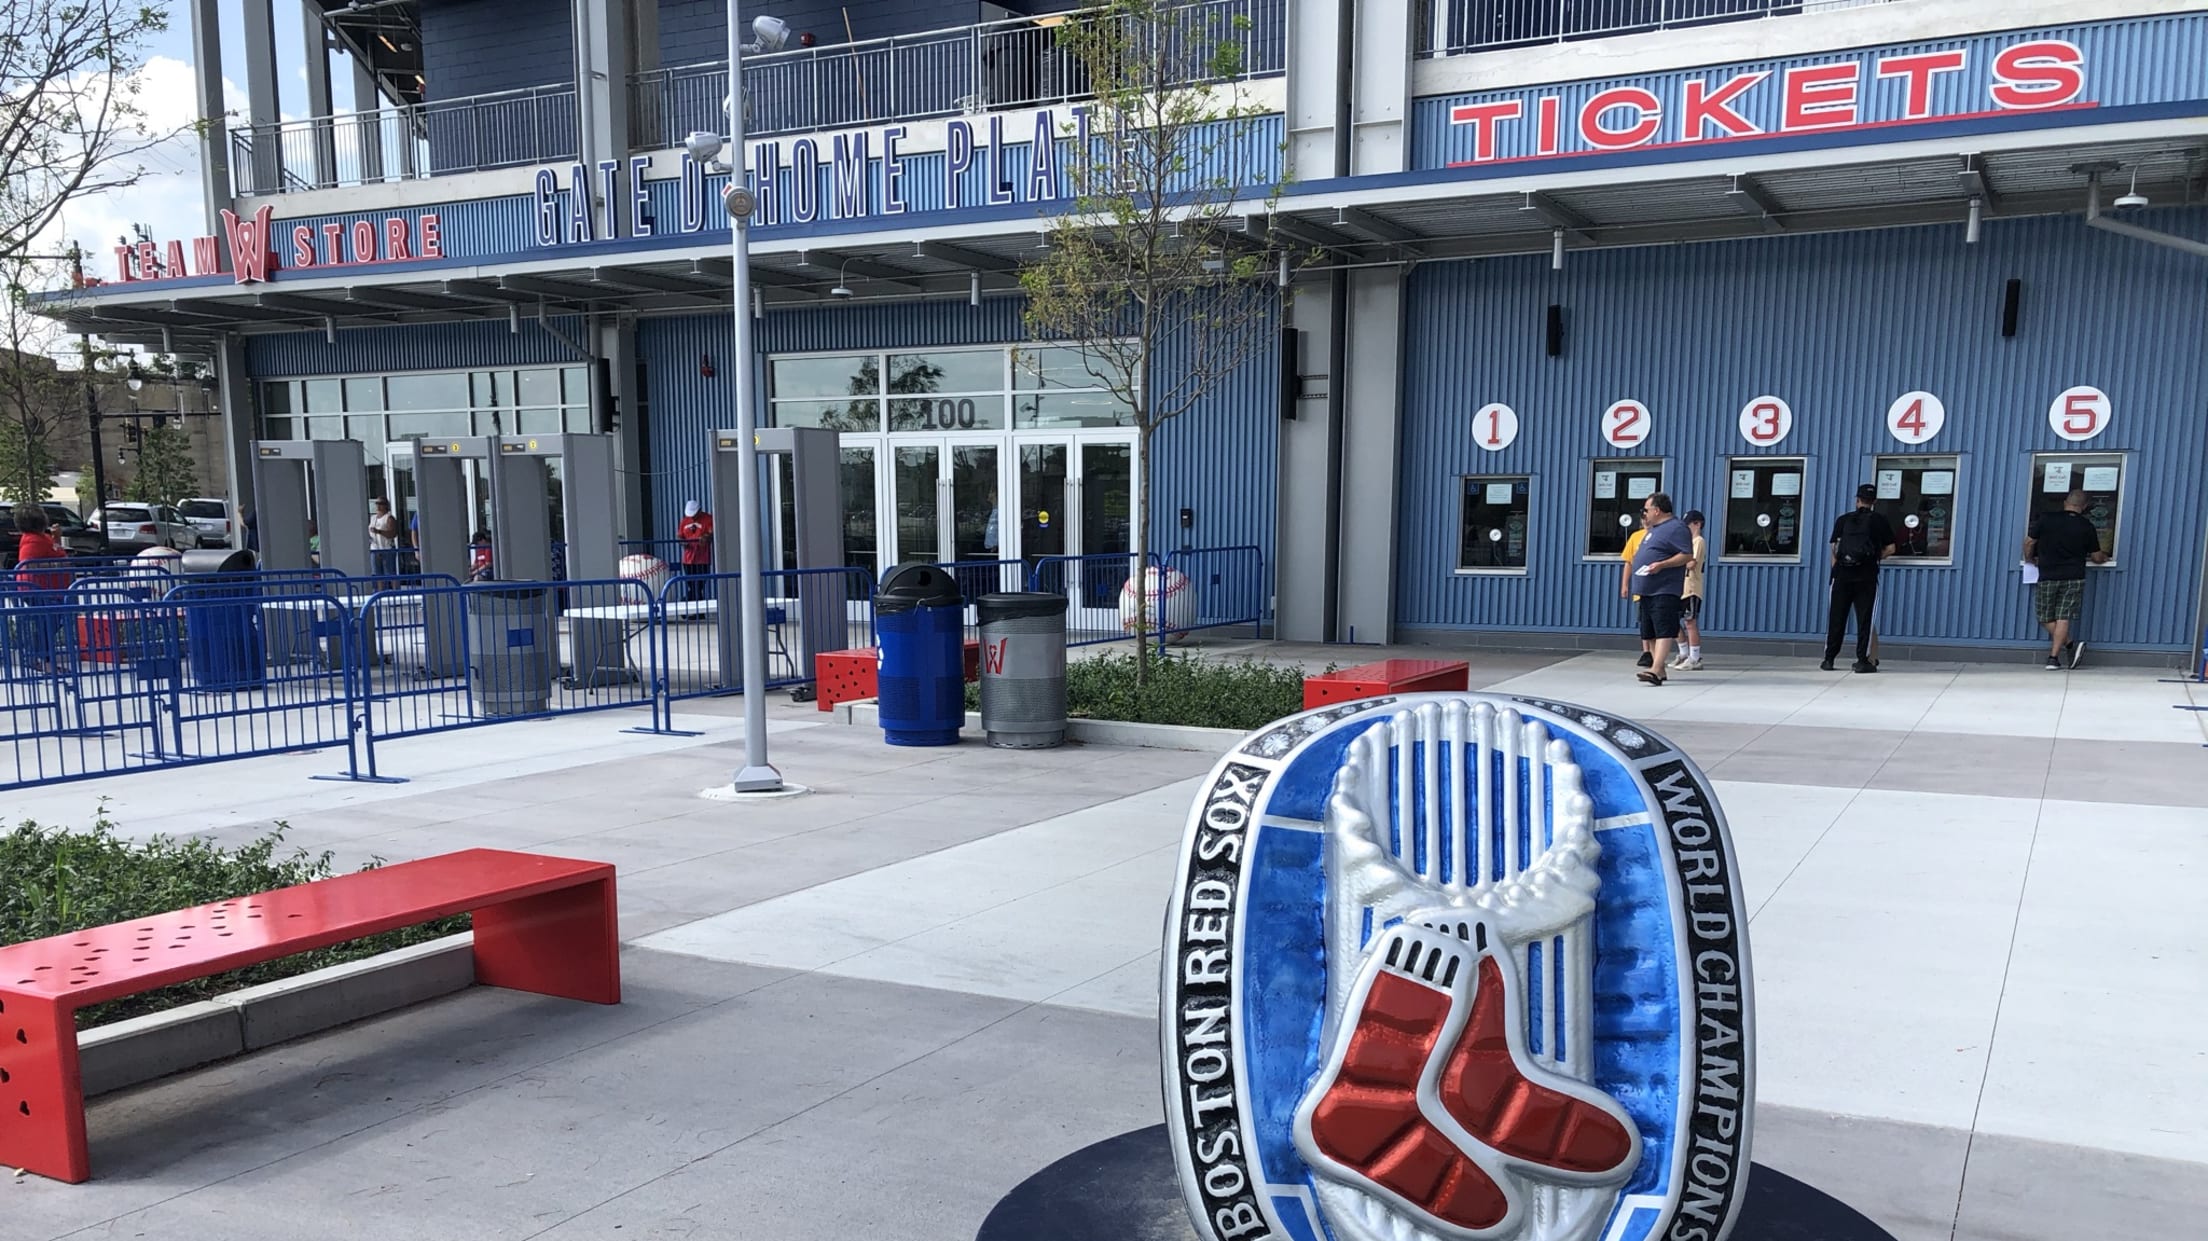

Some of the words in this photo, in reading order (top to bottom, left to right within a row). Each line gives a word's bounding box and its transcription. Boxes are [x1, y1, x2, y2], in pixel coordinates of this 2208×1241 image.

[1450, 39, 2085, 162] TICKETS
[535, 155, 652, 247] GATE
[680, 151, 704, 233] D
[754, 126, 906, 227] HOME
[945, 101, 1138, 210] PLATE
[114, 235, 221, 282] TEAM
[293, 214, 444, 267] STORE
[920, 398, 975, 429] 100
[1487, 409, 1502, 445] 1
[1612, 405, 1642, 442] 2
[1751, 403, 1783, 441] 3
[1896, 399, 1927, 437] 4
[2063, 394, 2100, 435] 5
[1199, 769, 1264, 864] SOX
[1653, 769, 1731, 941] WORLD
[1185, 879, 1232, 985] RED
[1184, 1005, 1267, 1241] BOSTON
[1670, 950, 1739, 1241] CHAMPIONS
